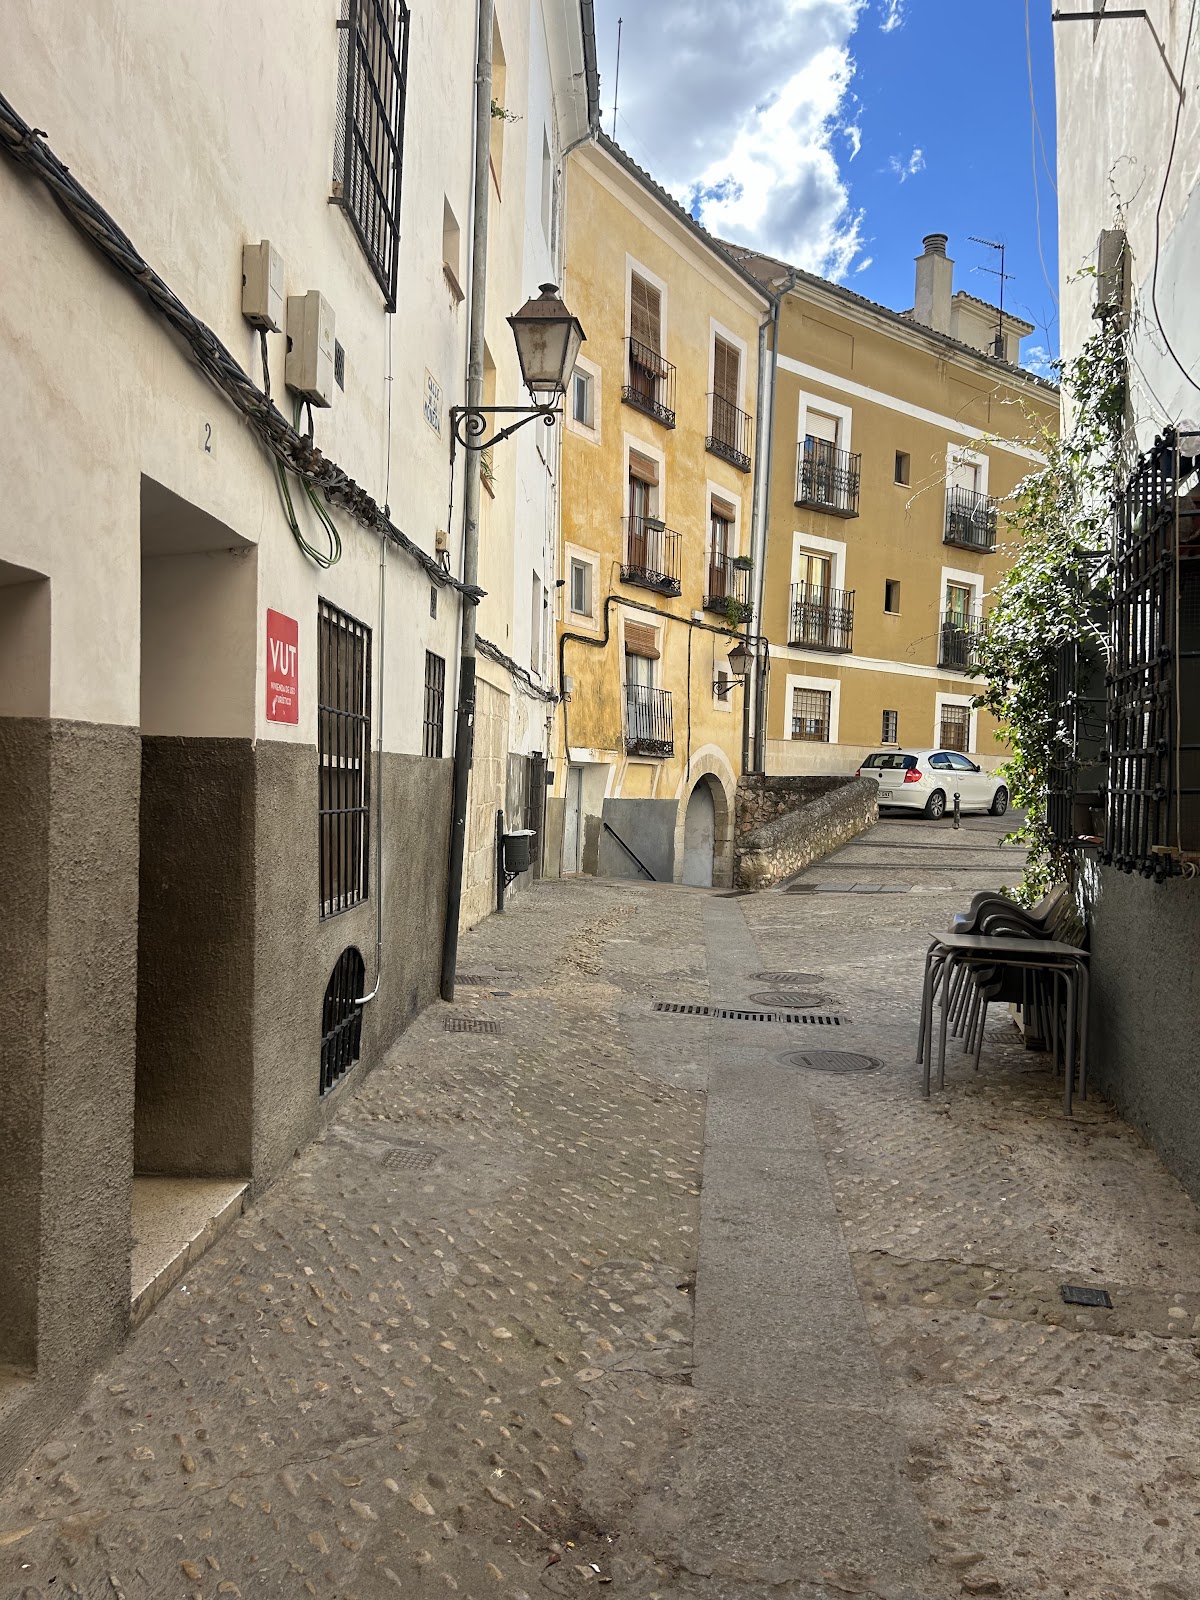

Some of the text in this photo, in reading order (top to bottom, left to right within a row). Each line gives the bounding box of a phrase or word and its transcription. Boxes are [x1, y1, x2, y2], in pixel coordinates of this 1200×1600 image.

[428, 376, 440, 400] CALLE
[204, 422, 212, 454] 2
[270, 638, 296, 678] VUT
